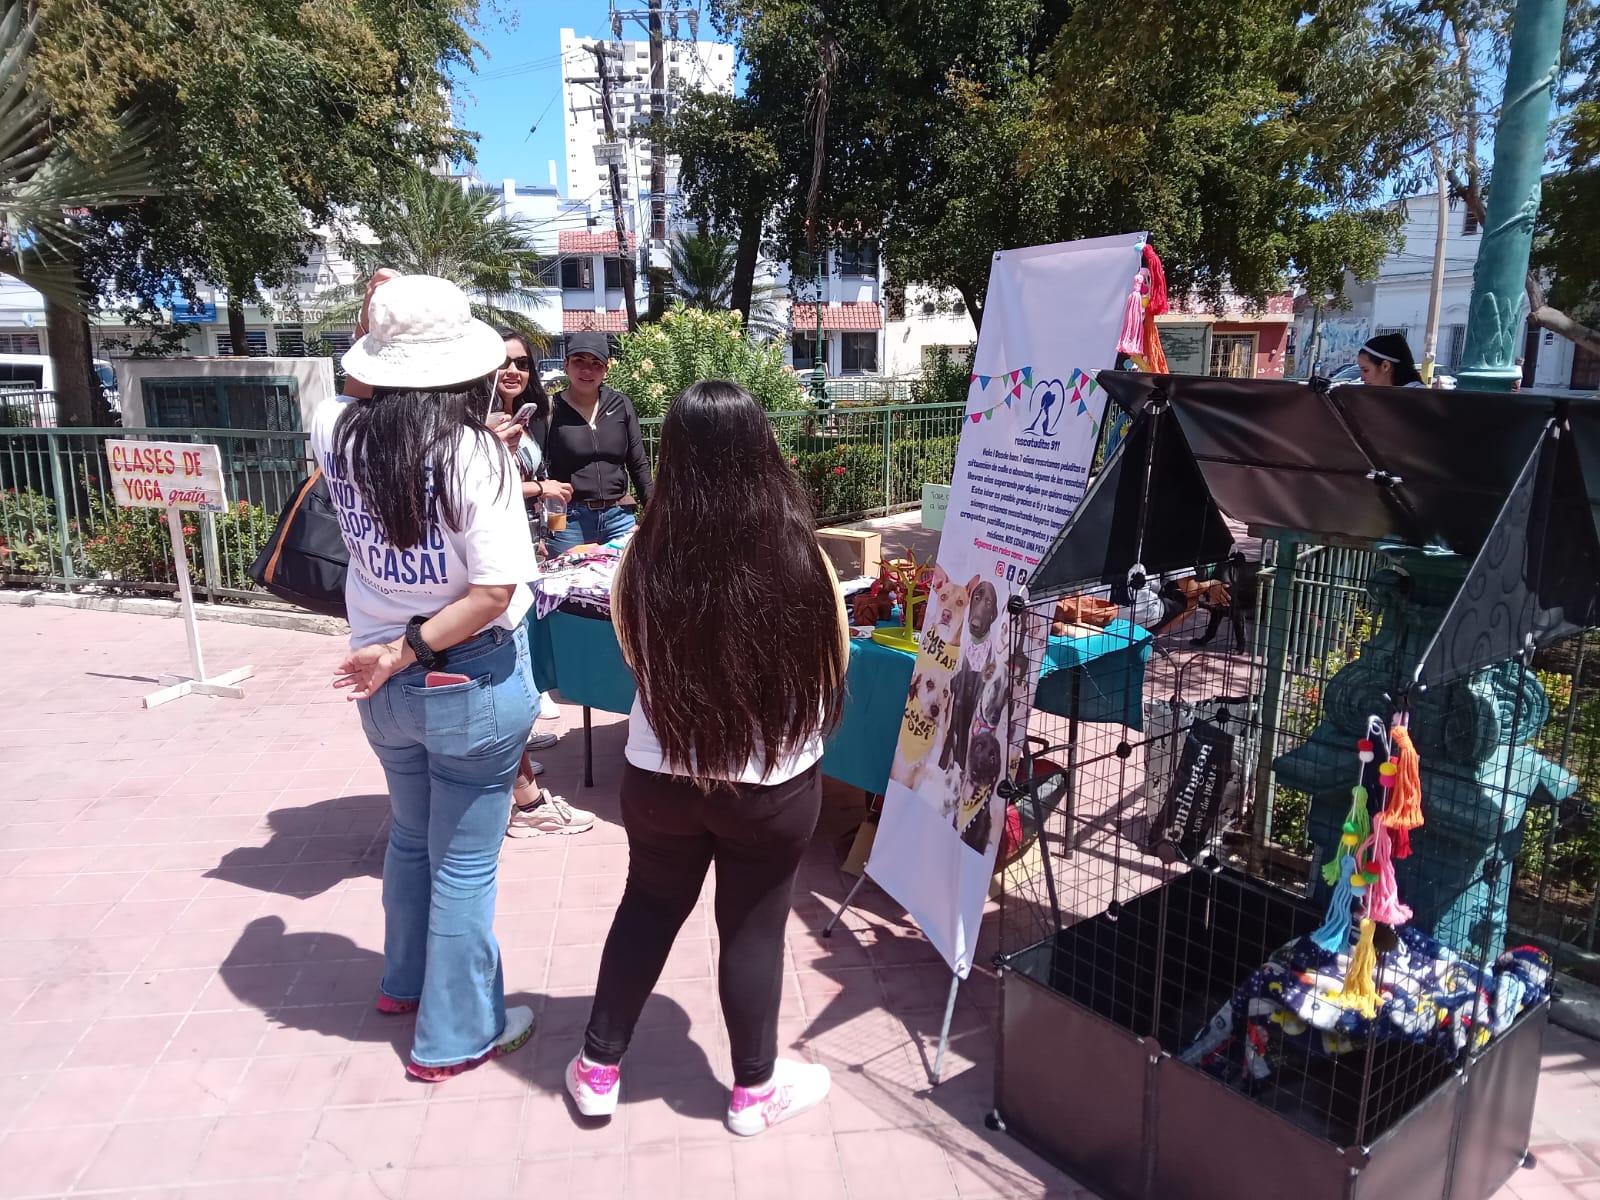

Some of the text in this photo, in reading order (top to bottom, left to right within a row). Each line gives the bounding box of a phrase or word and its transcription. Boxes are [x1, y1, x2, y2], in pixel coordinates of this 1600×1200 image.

[1015, 437, 1061, 451] rescataditos 911
[112, 445, 203, 477] CLASES DE
[995, 450, 1009, 460] Desde
[1009, 452, 1019, 462] hace
[1023, 454, 1035, 465] años
[1035, 458, 1061, 470] rescatamos
[1060, 461, 1081, 473] peluditos
[967, 471, 984, 482] llevan
[984, 474, 994, 485] años
[994, 478, 1018, 490] esperando
[1017, 484, 1026, 492] por
[1025, 484, 1041, 495] alguien
[1040, 489, 1049, 497] que
[991, 463, 998, 472] de
[998, 464, 1009, 474] calle
[1050, 474, 1057, 483] de
[1056, 475, 1064, 485] los
[122, 477, 213, 506] YOGA gratis
[971, 485, 984, 496] Esta
[1000, 494, 1016, 503] posible
[1015, 497, 1033, 507] gracias
[1047, 503, 1055, 513] tus
[988, 504, 1008, 515] estamos
[1033, 514, 1050, 526] hogares
[986, 518, 1006, 529] pastillas
[1005, 522, 1016, 531] para
[1022, 527, 1046, 540] garrapatas
[992, 545, 999, 553] en
[998, 546, 1011, 557] redes
[1004, 535, 1014, 545] NOS
[1013, 537, 1027, 549] ECHAS
[1026, 541, 1035, 552] UNA
[1035, 543, 1046, 555] PATA
[368, 545, 449, 585] CASA!
[1162, 743, 1213, 842] Burlington
